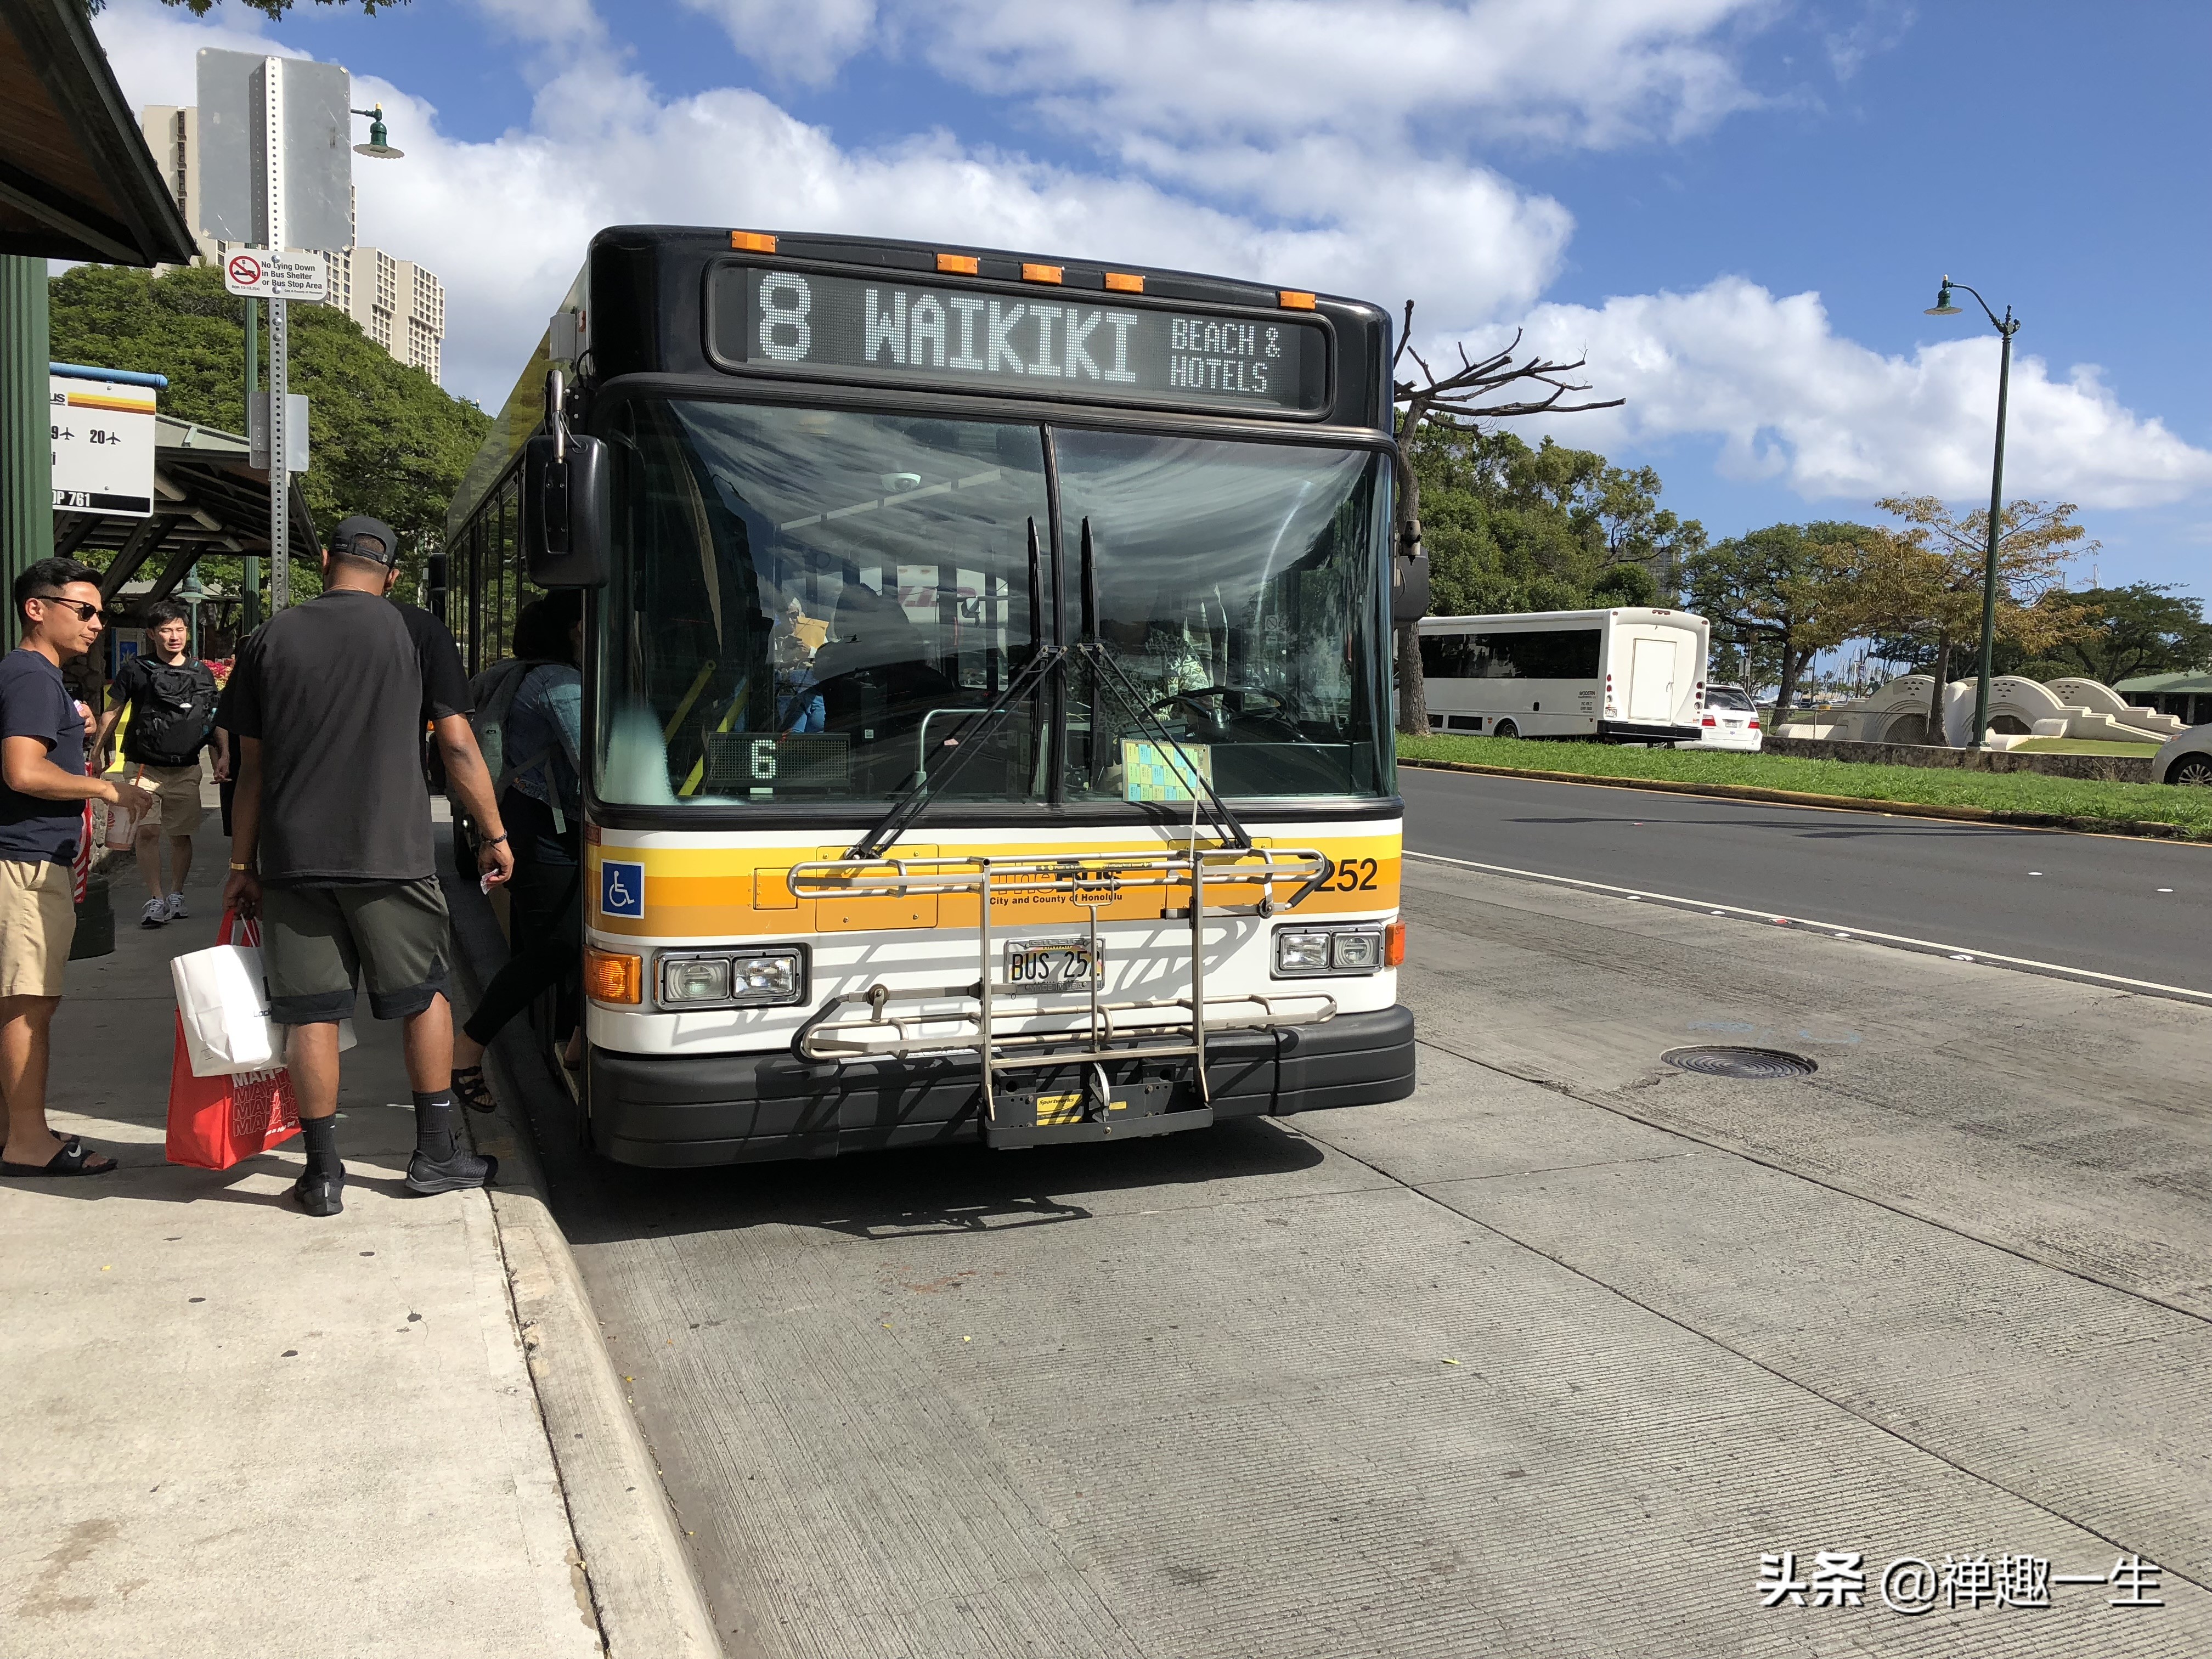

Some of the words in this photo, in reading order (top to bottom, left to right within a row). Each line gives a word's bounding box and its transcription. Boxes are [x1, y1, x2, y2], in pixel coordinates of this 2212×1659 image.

[274, 262, 292, 272] Lying
[295, 263, 315, 272] Down
[286, 271, 313, 280] Shelter
[287, 280, 304, 289] Stop
[306, 281, 323, 290] Area
[759, 272, 811, 362] 8
[865, 289, 1138, 383] WAIKIKI
[1171, 318, 1255, 356] BEACH
[1265, 326, 1281, 358] &
[1171, 355, 1268, 393] HOTELS
[89, 429, 105, 444] 20
[69, 492, 90, 507] 761
[751, 739, 776, 779] 6
[1314, 857, 1378, 892] 252
[990, 897, 1009, 906] City
[1012, 896, 1030, 904] and
[1032, 895, 1066, 904] County
[1069, 894, 1080, 902] of
[1081, 893, 1122, 901] Honolulu
[1012, 952, 1049, 981] BUS
[1029, 983, 1053, 992] MADE
[1056, 983, 1064, 991] IN
[1069, 981, 1083, 990] USA
[1039, 1098, 1075, 1106] Sportworks
